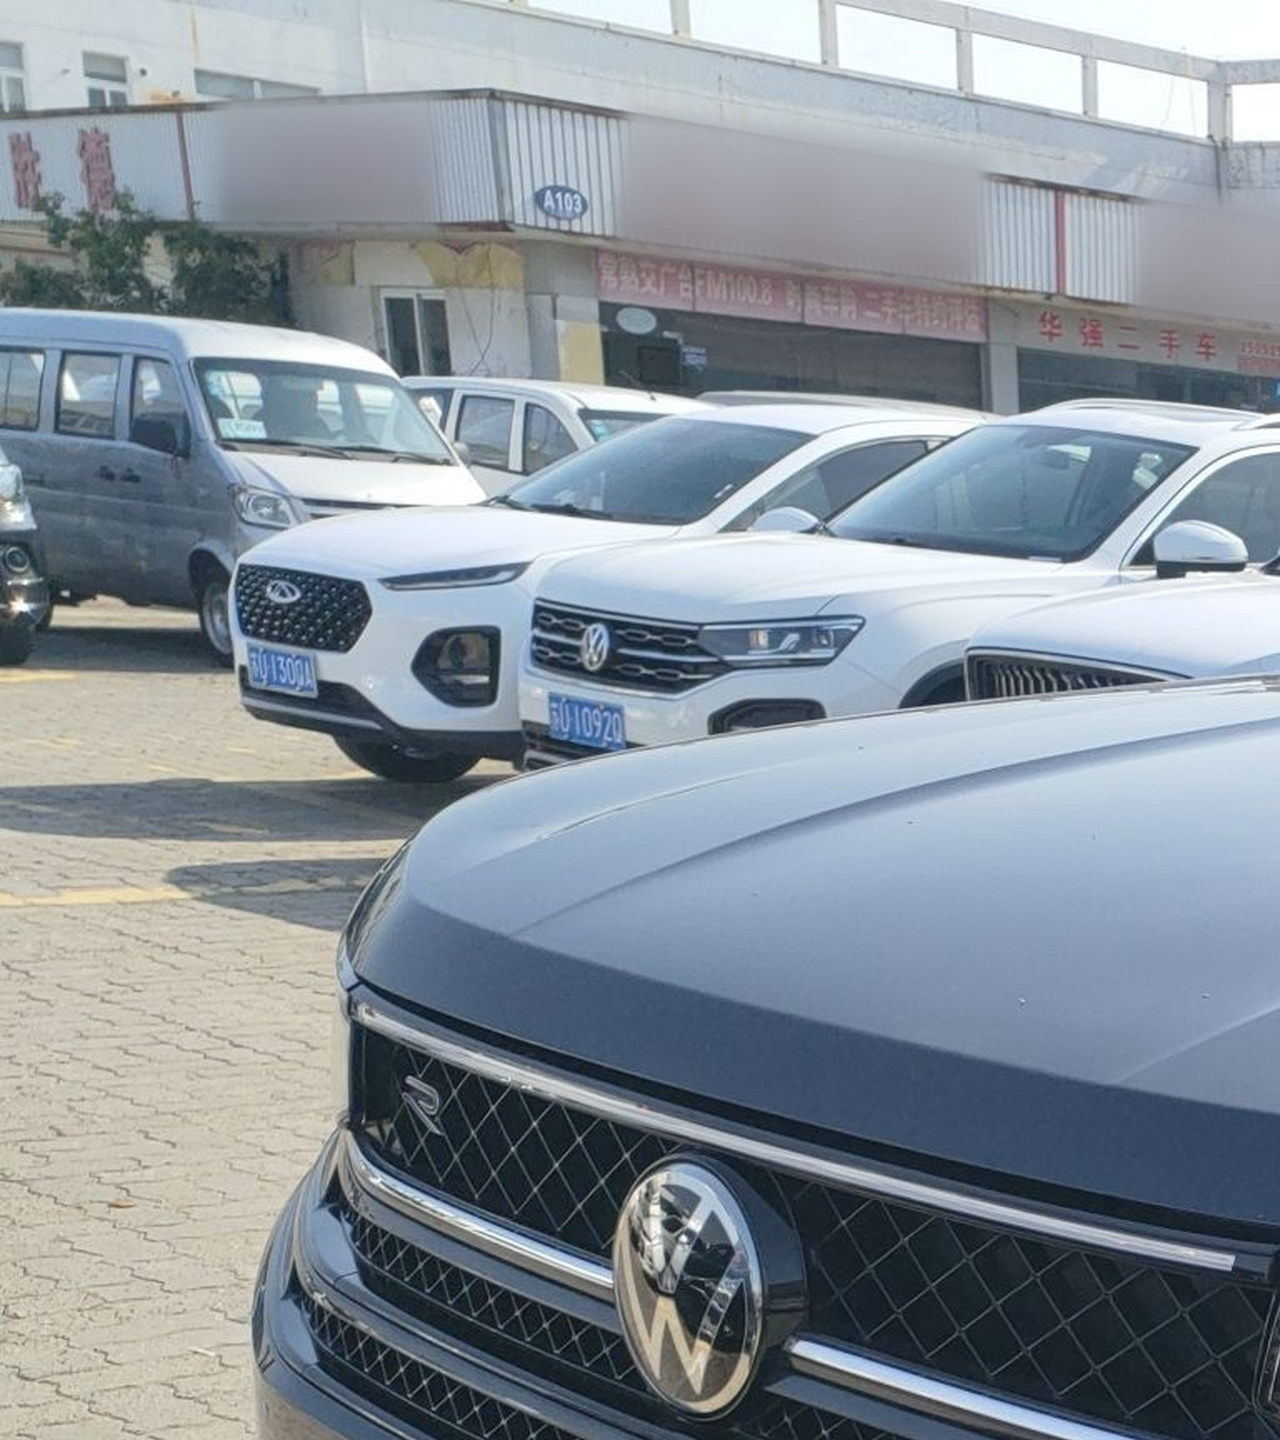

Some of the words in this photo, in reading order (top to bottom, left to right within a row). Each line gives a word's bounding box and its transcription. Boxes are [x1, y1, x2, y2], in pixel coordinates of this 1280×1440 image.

[543, 189, 582, 213] A103
[1038, 310, 1217, 361] 华强二手车
